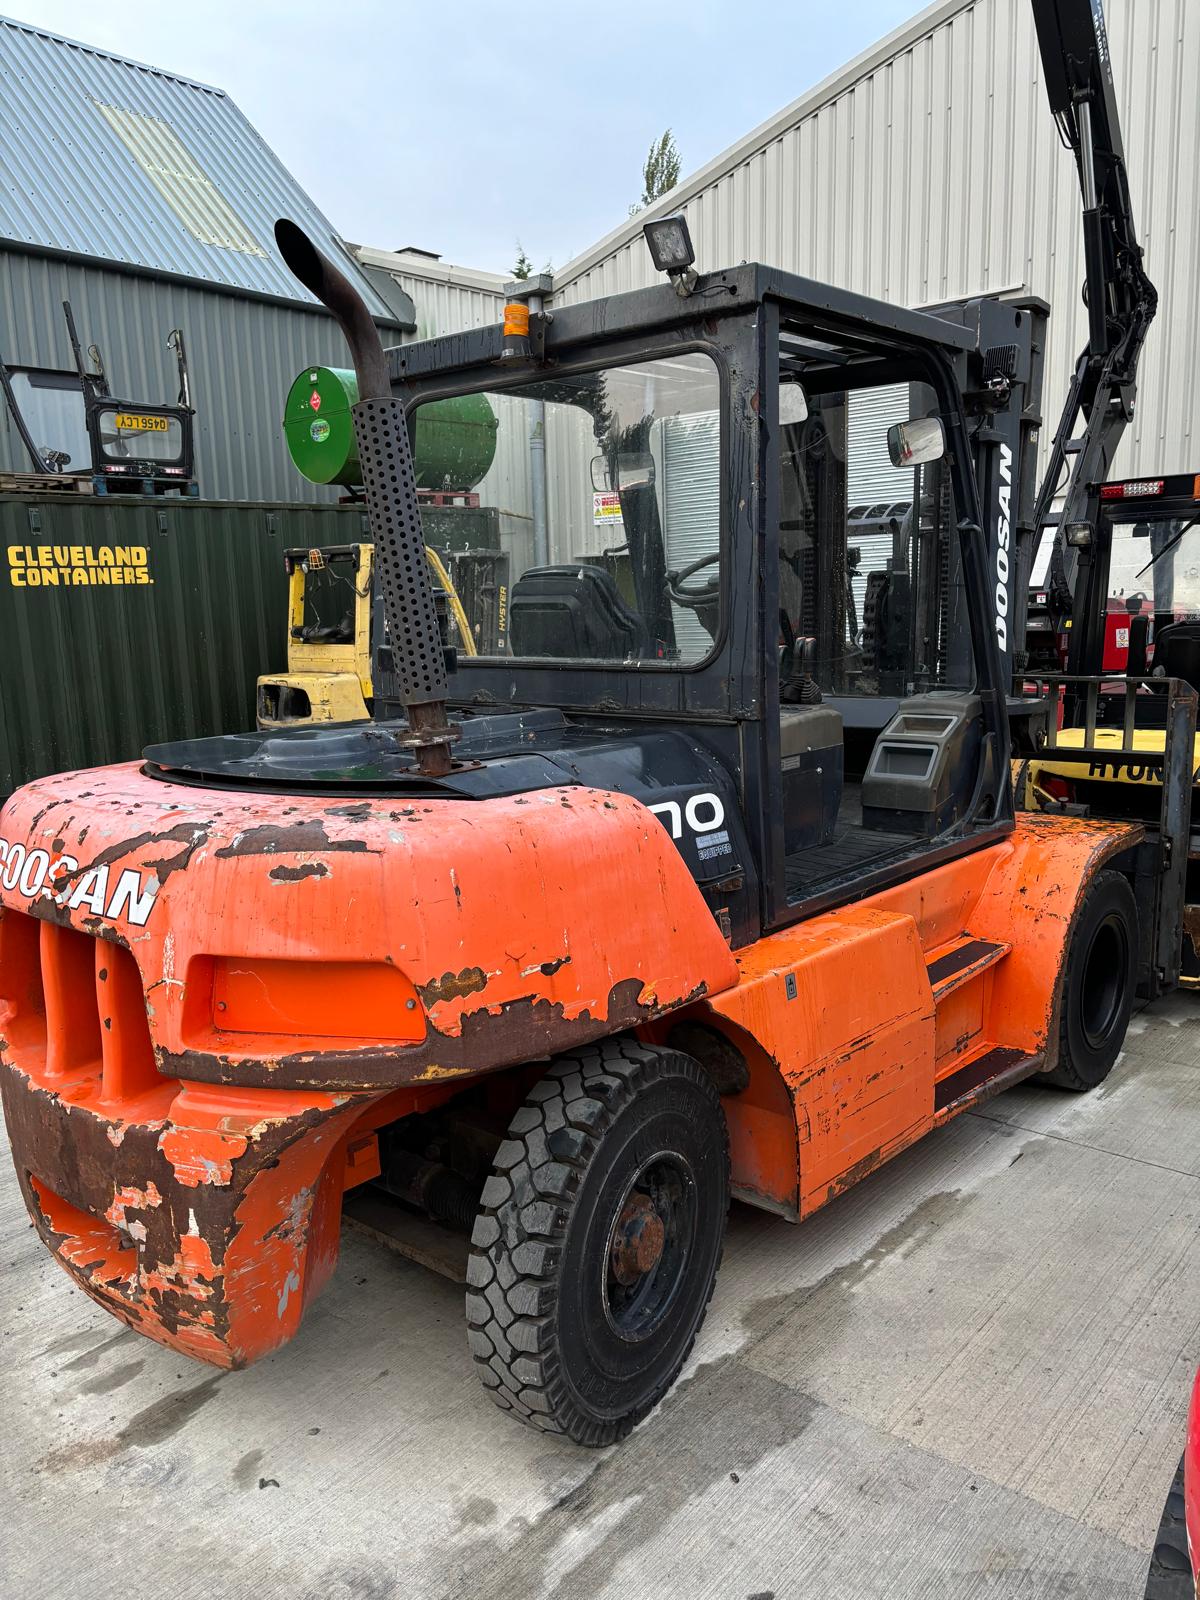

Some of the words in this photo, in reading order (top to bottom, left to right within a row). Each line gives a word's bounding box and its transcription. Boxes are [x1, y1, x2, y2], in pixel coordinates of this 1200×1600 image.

[7, 545, 147, 567] CLEVELAND
[996, 443, 1012, 652] DOOSAN
[10, 567, 154, 586] CONTAINERS.
[498, 585, 507, 632] HYSTER
[646, 793, 724, 839] 70
